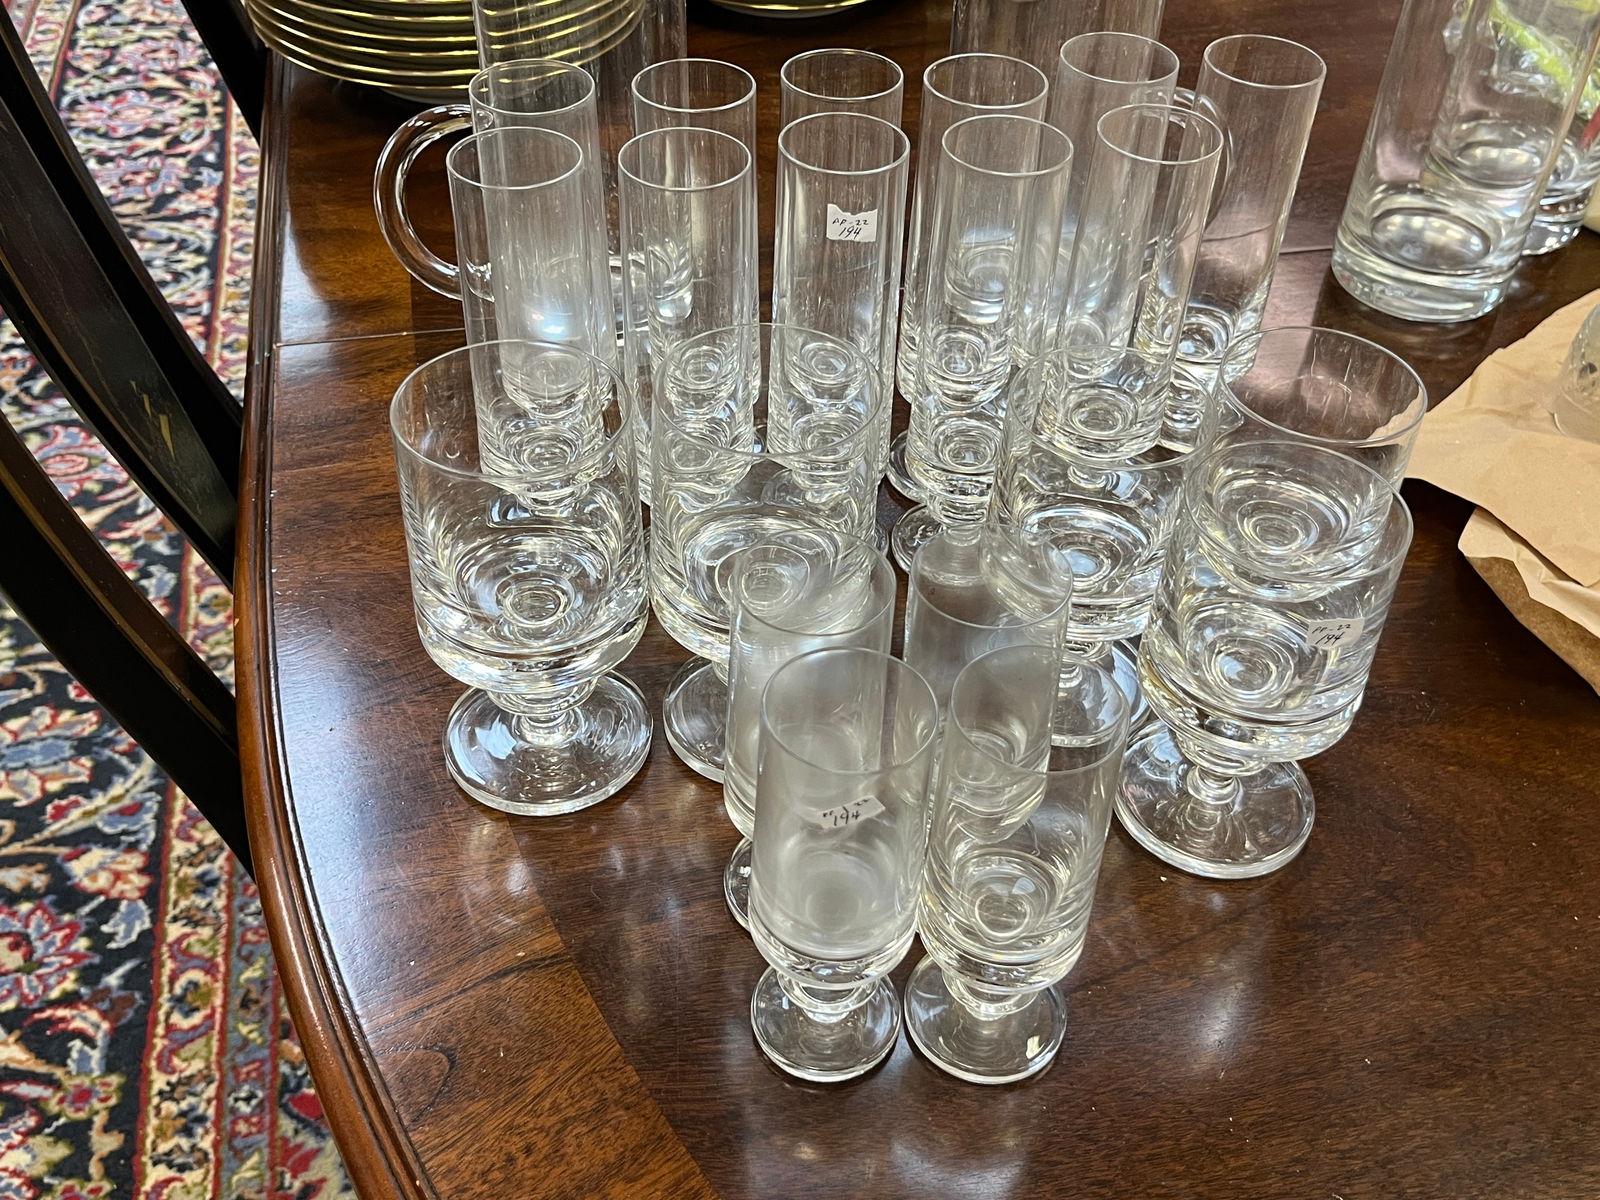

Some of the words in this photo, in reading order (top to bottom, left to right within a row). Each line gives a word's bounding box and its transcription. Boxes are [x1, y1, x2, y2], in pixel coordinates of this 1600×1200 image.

[838, 225, 862, 240] 194
[1315, 631, 1345, 646] 194
[833, 805, 861, 826] 194
